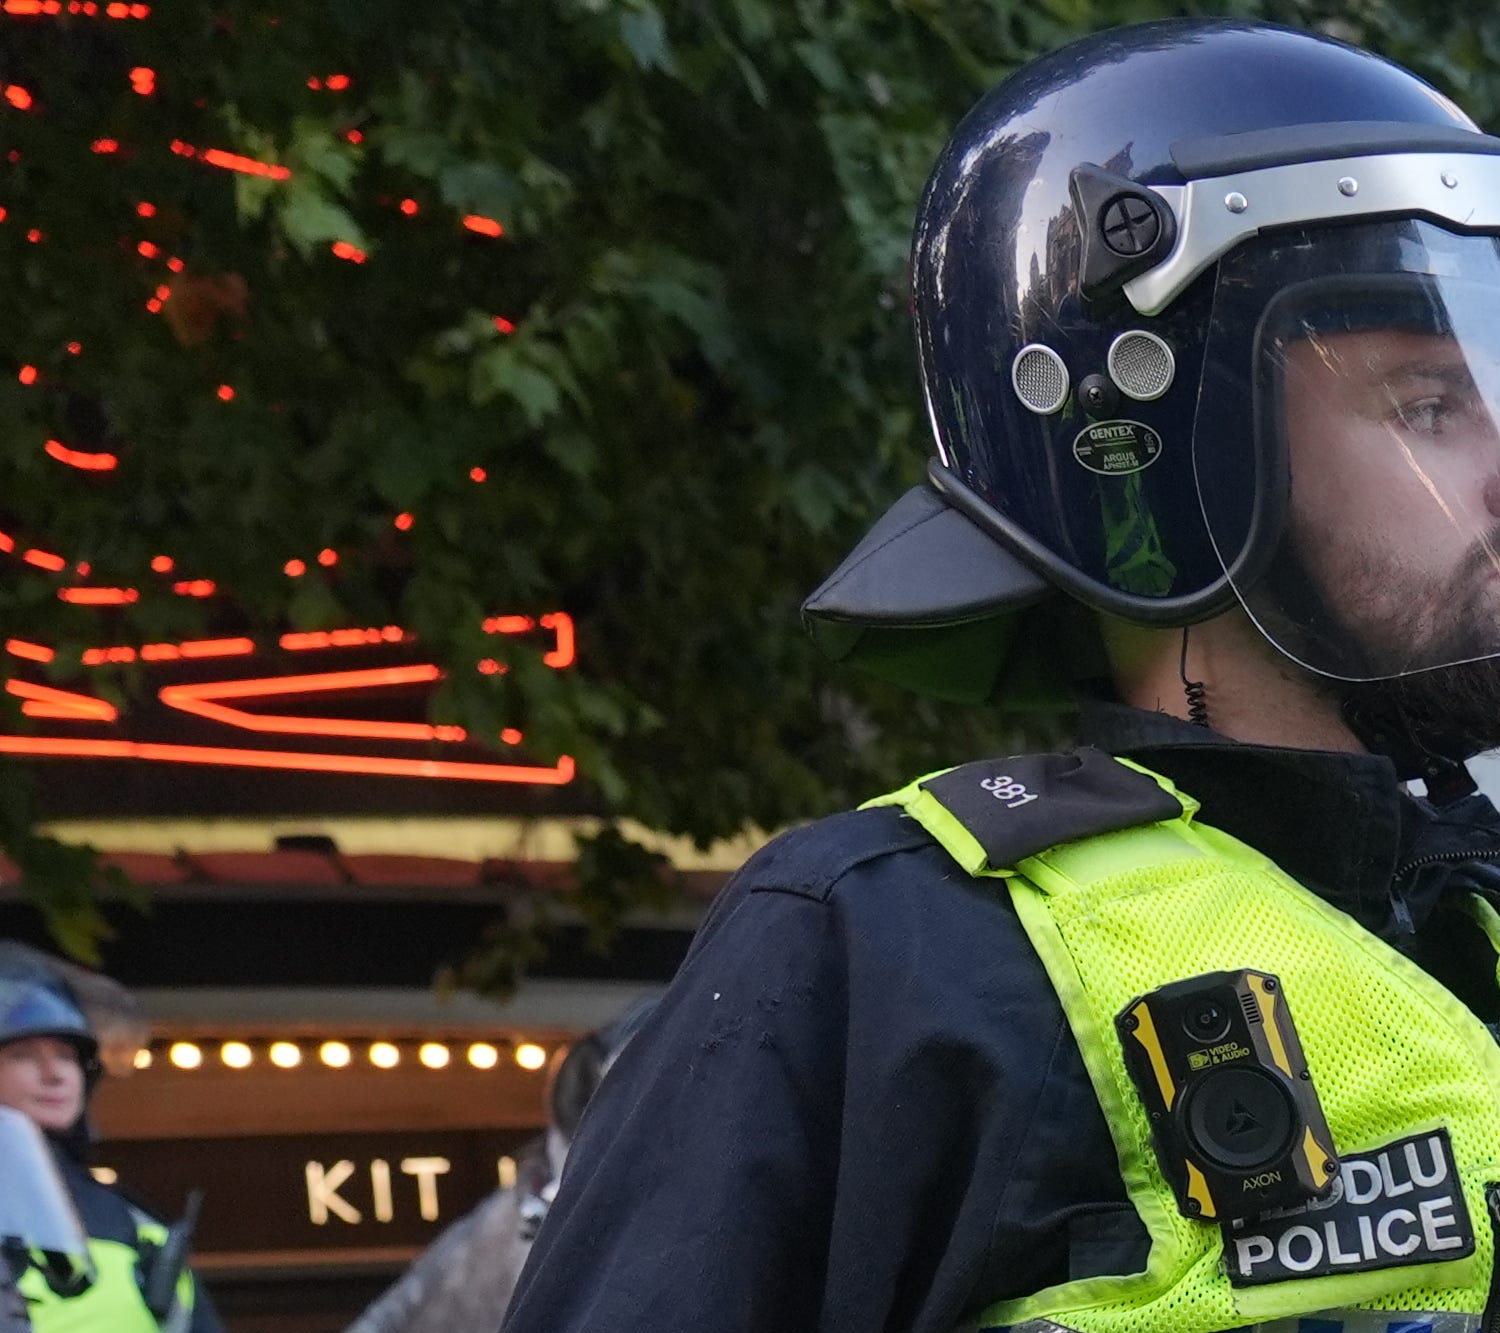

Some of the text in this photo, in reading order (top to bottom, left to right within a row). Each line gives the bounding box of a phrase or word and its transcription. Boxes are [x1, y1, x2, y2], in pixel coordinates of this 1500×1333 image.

[1089, 425, 1135, 440] GENTEX
[1103, 451, 1136, 463] ARGUS
[980, 775, 1039, 809] 381
[1209, 1042, 1239, 1056] VIDEO
[1221, 1047, 1250, 1062] AUDIO
[1242, 1170, 1283, 1192] AXON
[305, 1156, 451, 1226] KIT
[1232, 1195, 1464, 1277] POLICE
